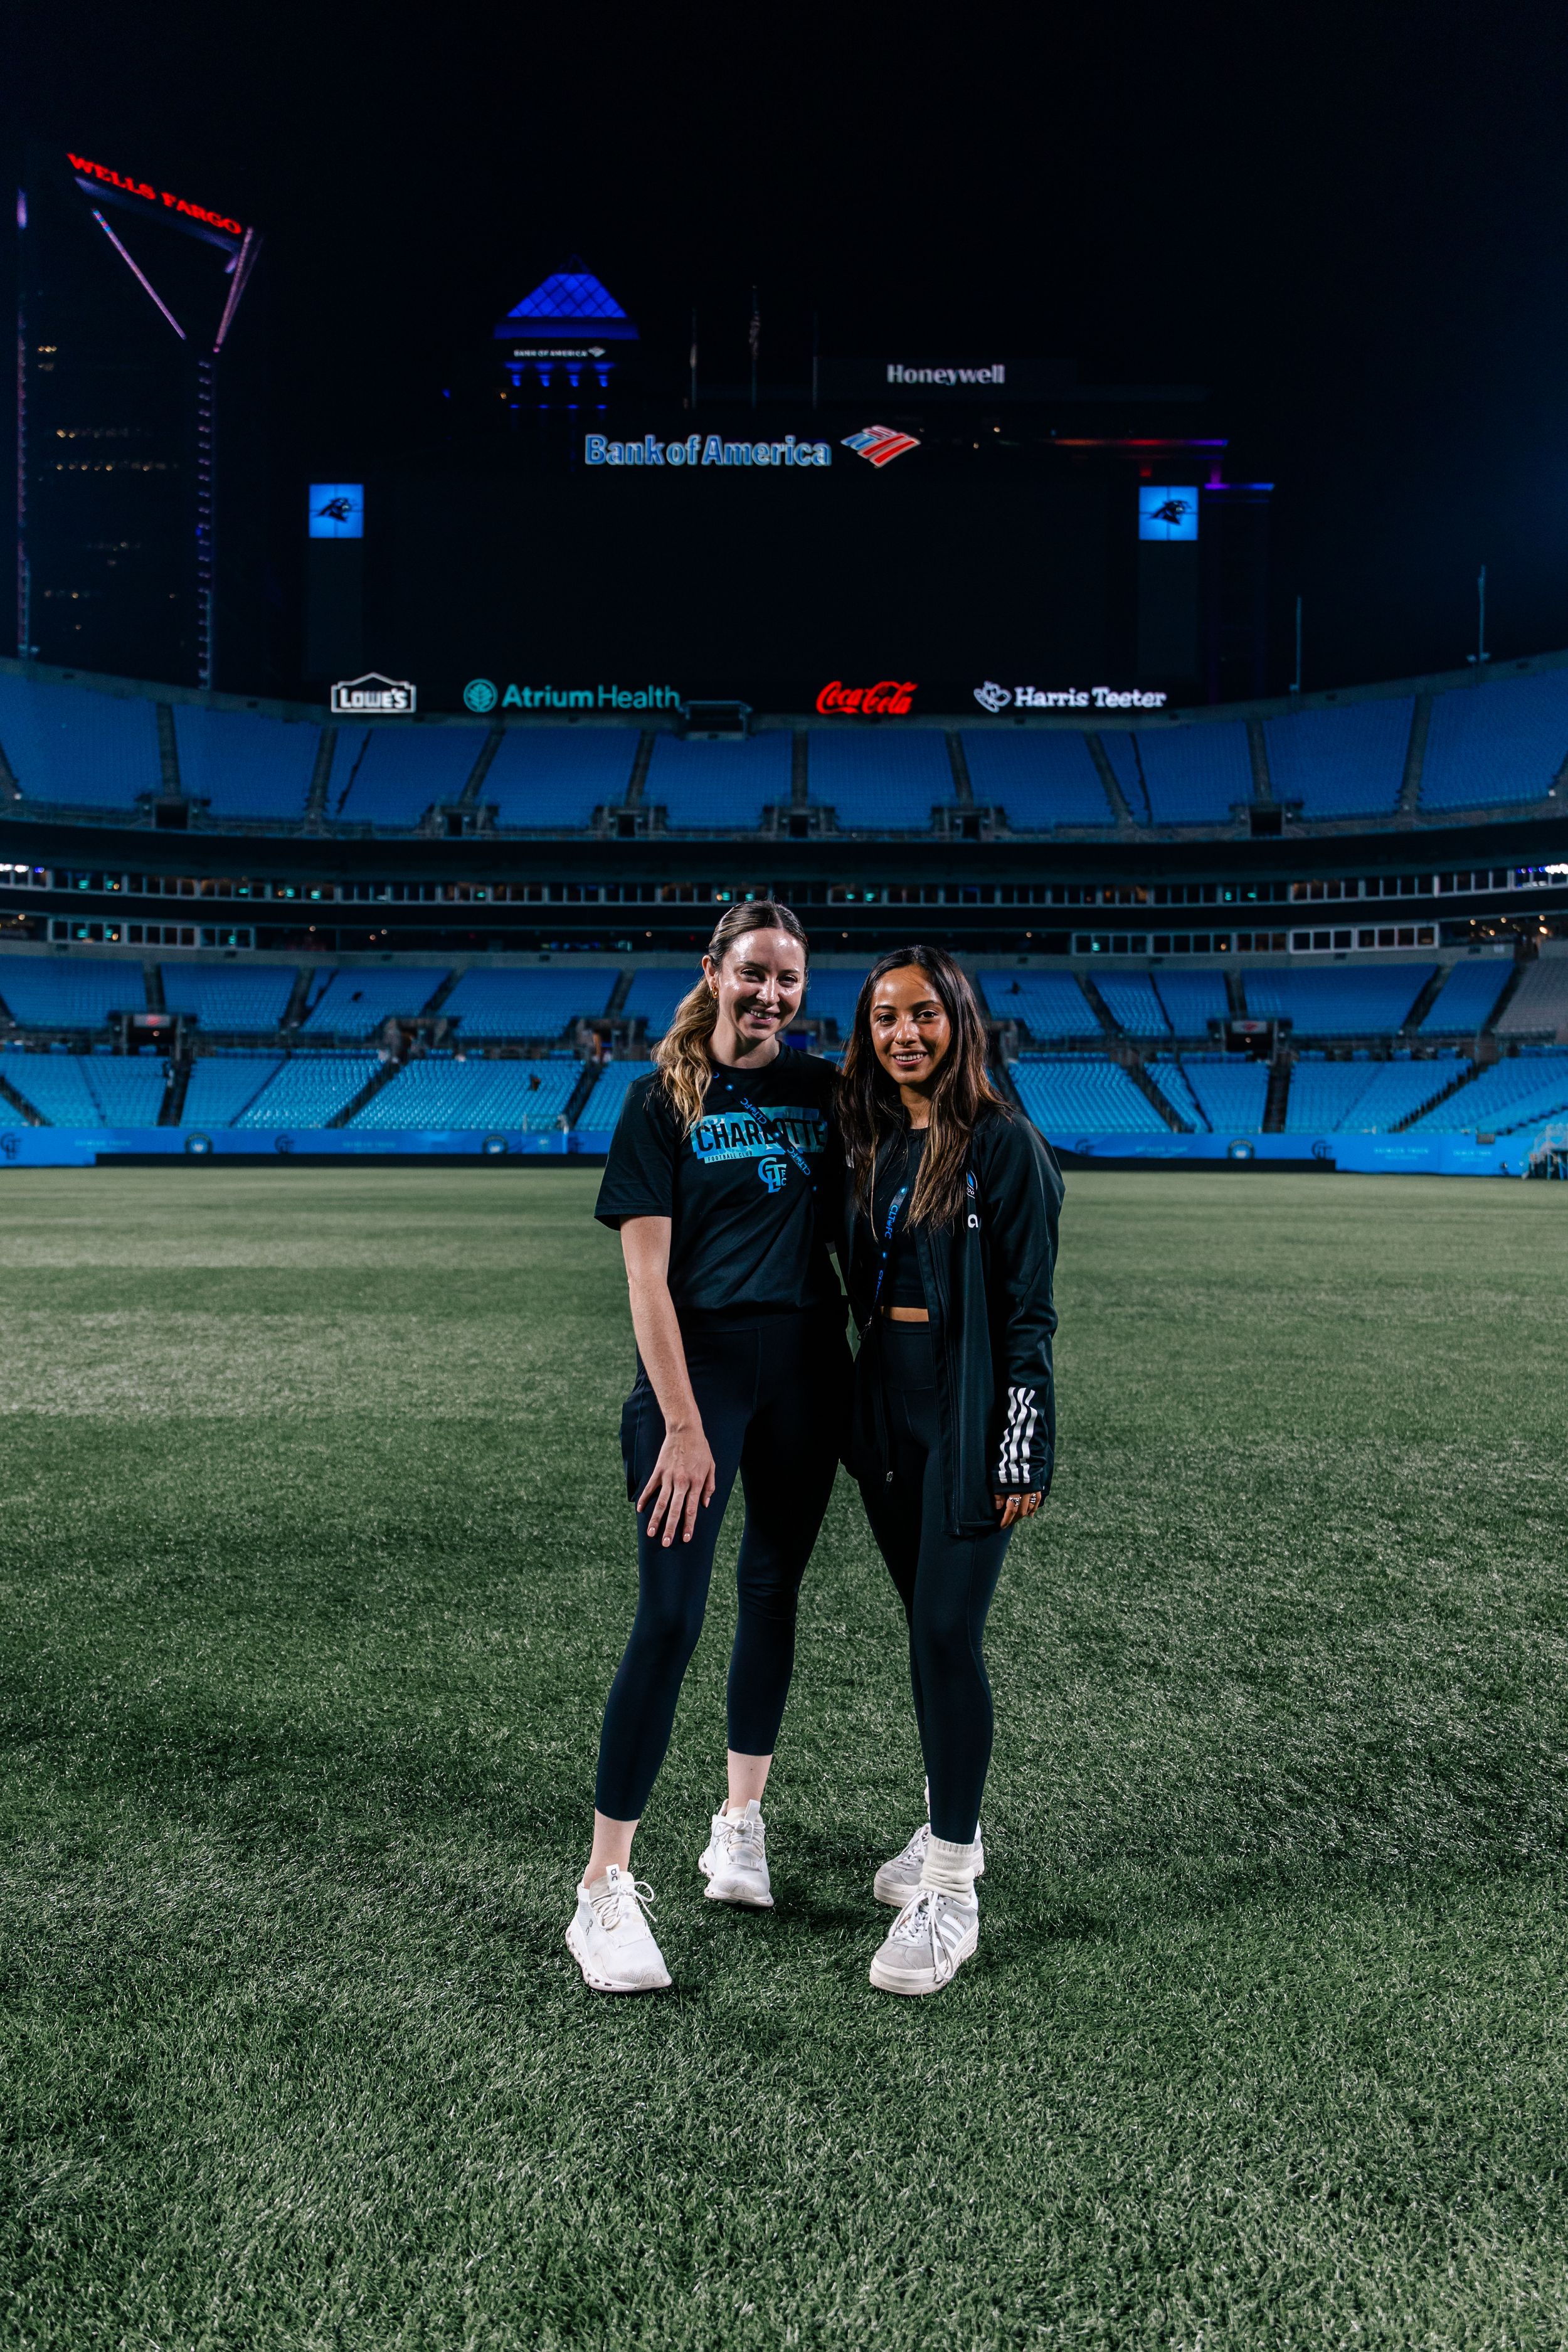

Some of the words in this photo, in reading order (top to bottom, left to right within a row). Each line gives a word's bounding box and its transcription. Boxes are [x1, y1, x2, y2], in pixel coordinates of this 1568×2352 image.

[67, 153, 156, 200] WELLS
[161, 191, 243, 235] FARGO
[887, 364, 1005, 386] Honeywell
[585, 434, 665, 467] Bank
[667, 434, 702, 467] of
[702, 434, 832, 467] America
[501, 684, 594, 708] Atrium
[598, 685, 681, 709] Health
[1014, 686, 1089, 707] Harris
[1091, 686, 1167, 708] Teeter
[708, 1153, 736, 1162] FOOTBALL
